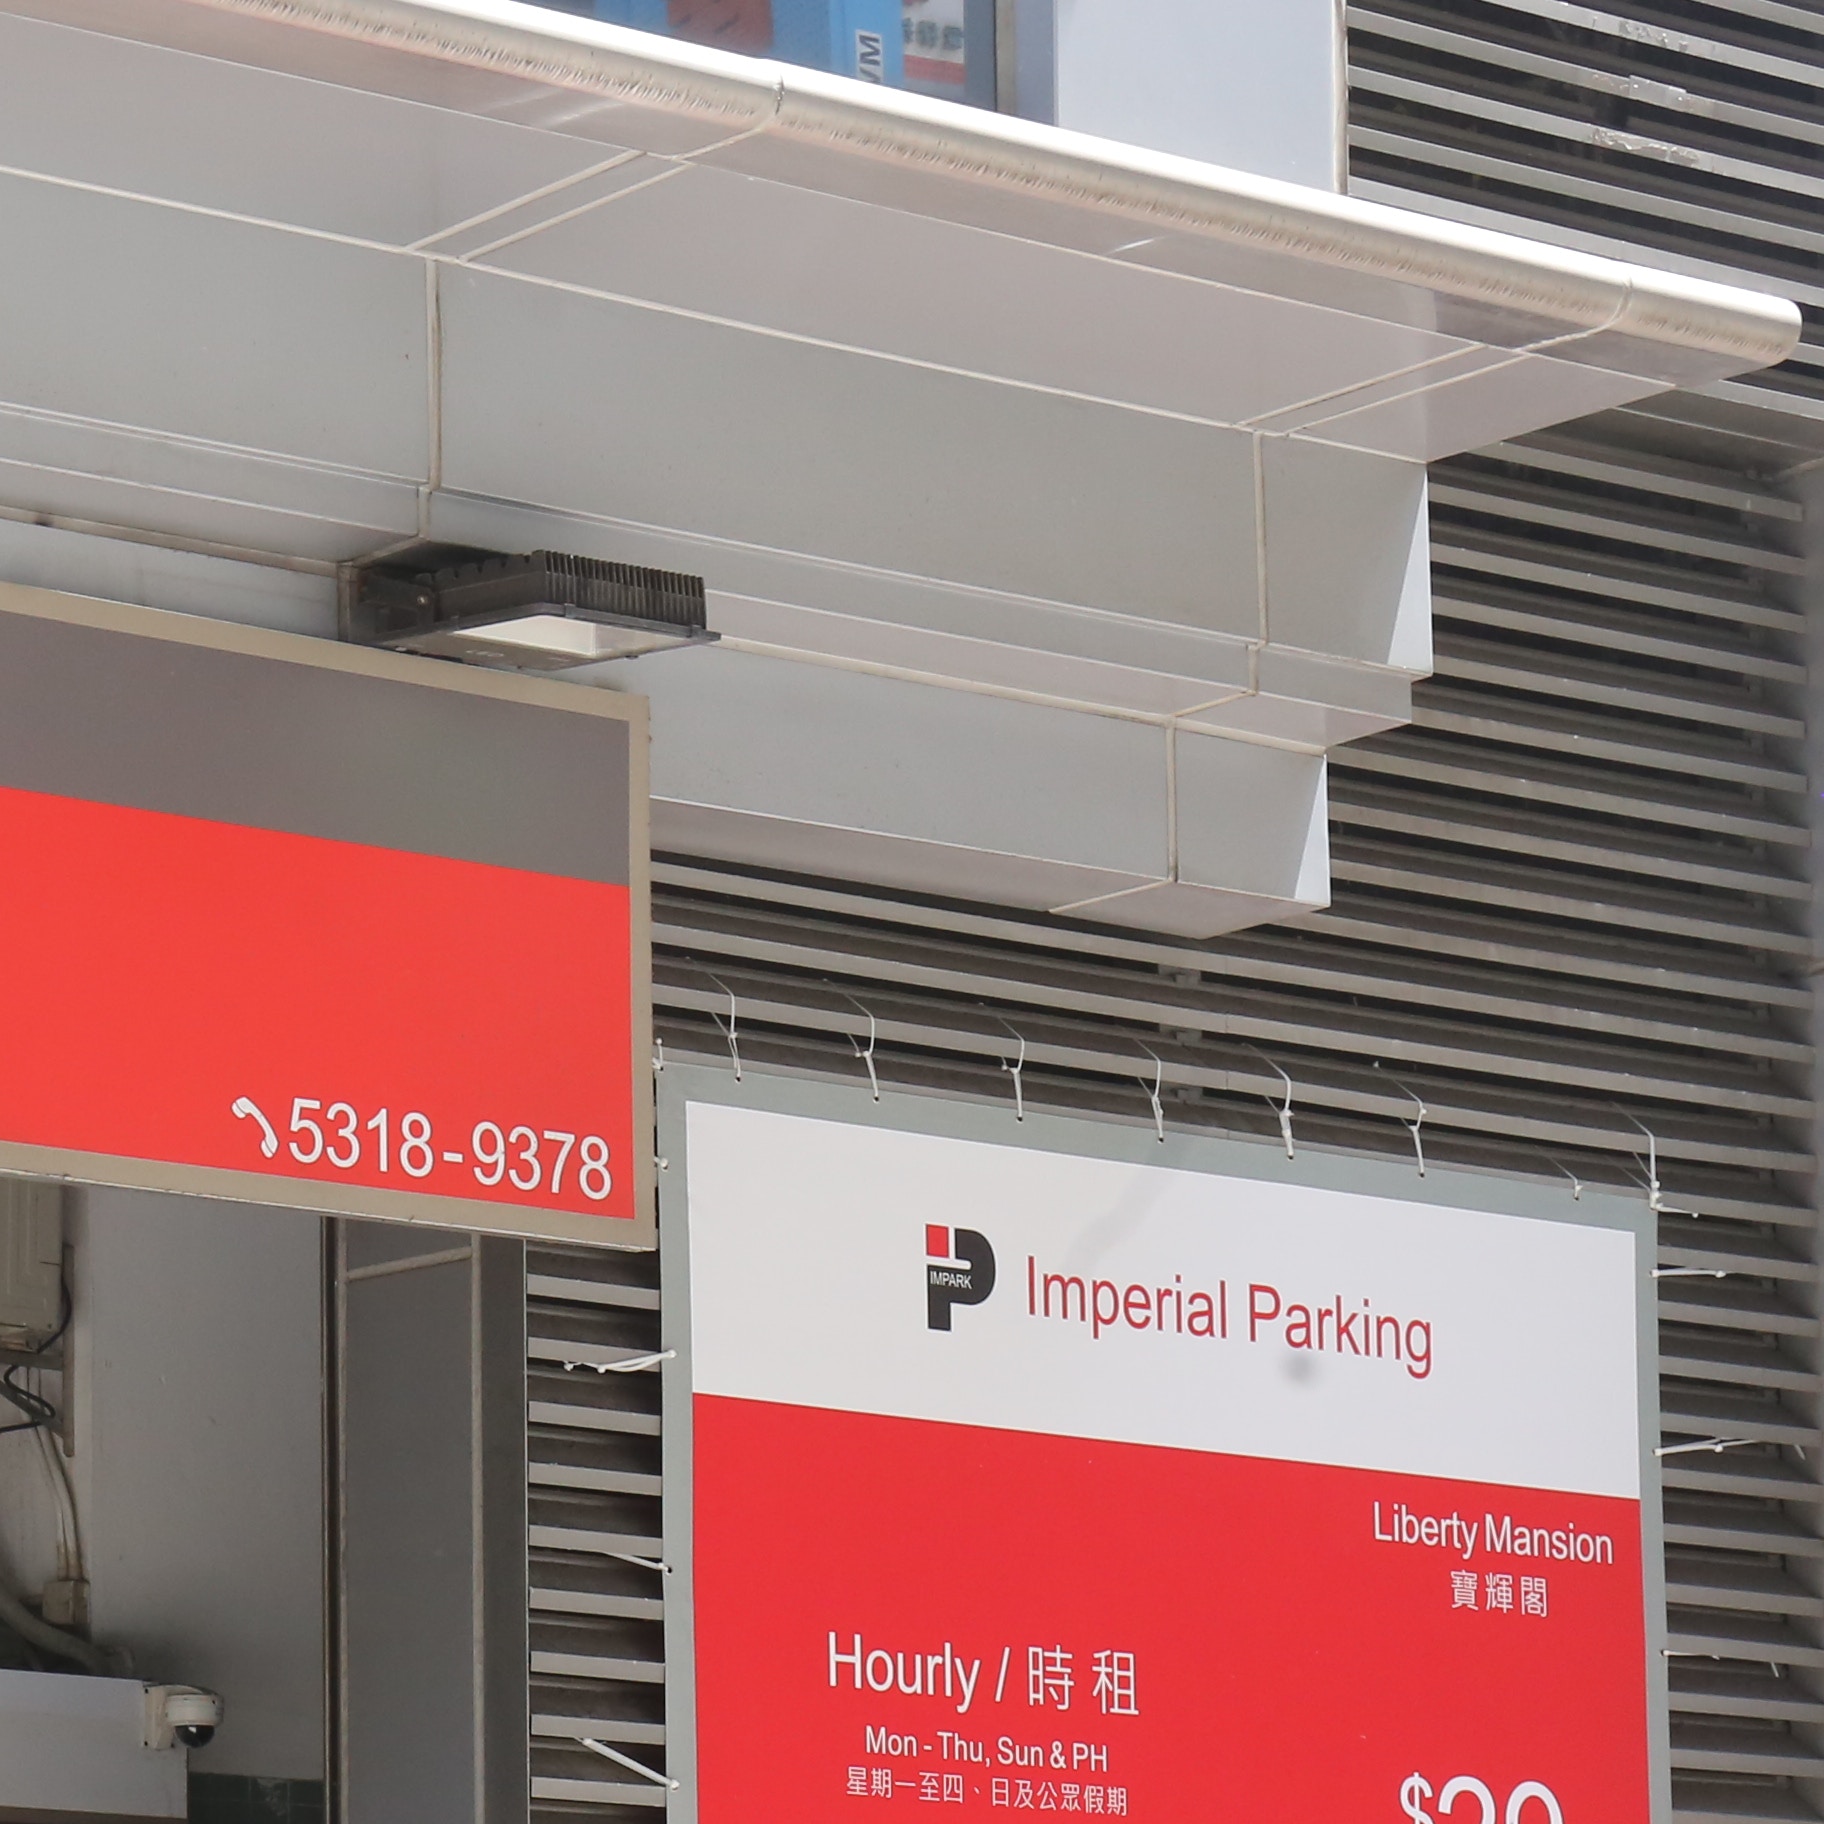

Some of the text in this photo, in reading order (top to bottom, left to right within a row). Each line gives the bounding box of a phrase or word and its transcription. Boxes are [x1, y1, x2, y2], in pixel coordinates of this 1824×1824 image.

[287, 1096, 613, 1201] 5318-9378
[929, 1270, 972, 1291] IMPARK
[1026, 1255, 1434, 1380] Imperial Parking
[1372, 1500, 1614, 1566] Liberty Mansion
[1450, 1569, 1549, 1619] 寶輝閣
[826, 1630, 982, 1714] Hourly
[864, 1724, 918, 1758] Mon
[936, 1730, 991, 1768] Thu,
[996, 1736, 1044, 1768] Sun
[1049, 1740, 1067, 1770] &
[1071, 1742, 1109, 1773] PH
